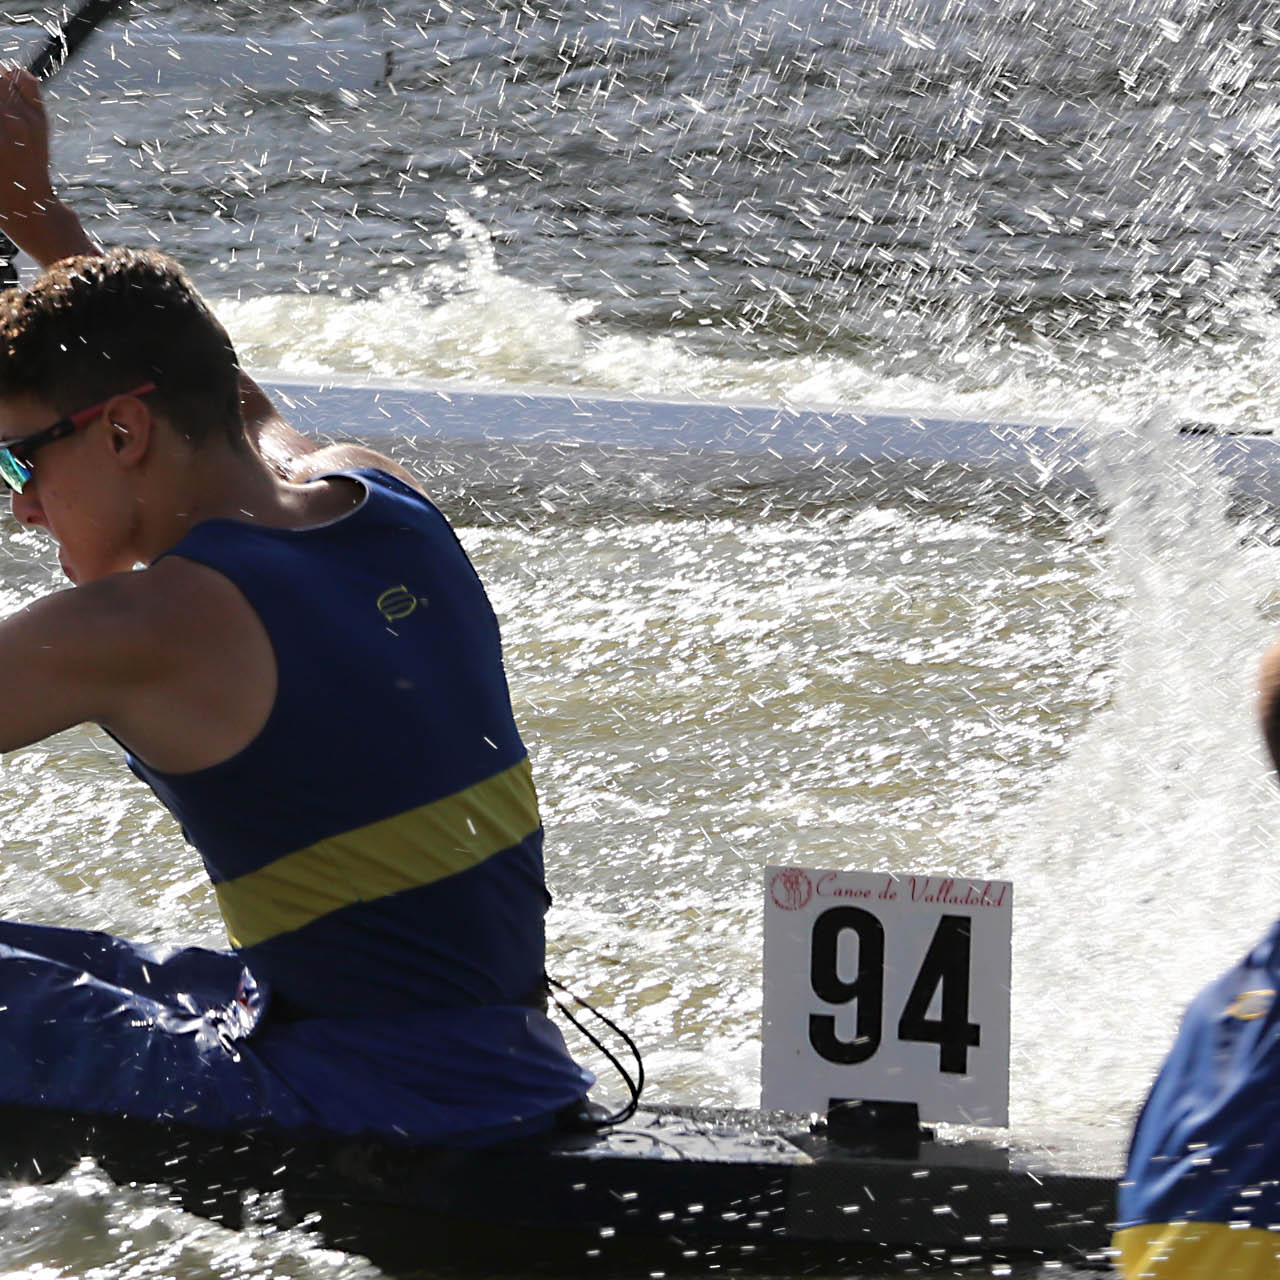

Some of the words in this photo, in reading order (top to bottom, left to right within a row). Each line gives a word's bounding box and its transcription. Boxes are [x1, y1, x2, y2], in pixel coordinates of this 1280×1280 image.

[816, 872, 869, 899] Canoe
[878, 878, 897, 900] de
[908, 876, 1007, 907] Valladolid
[809, 905, 981, 1075] 94
